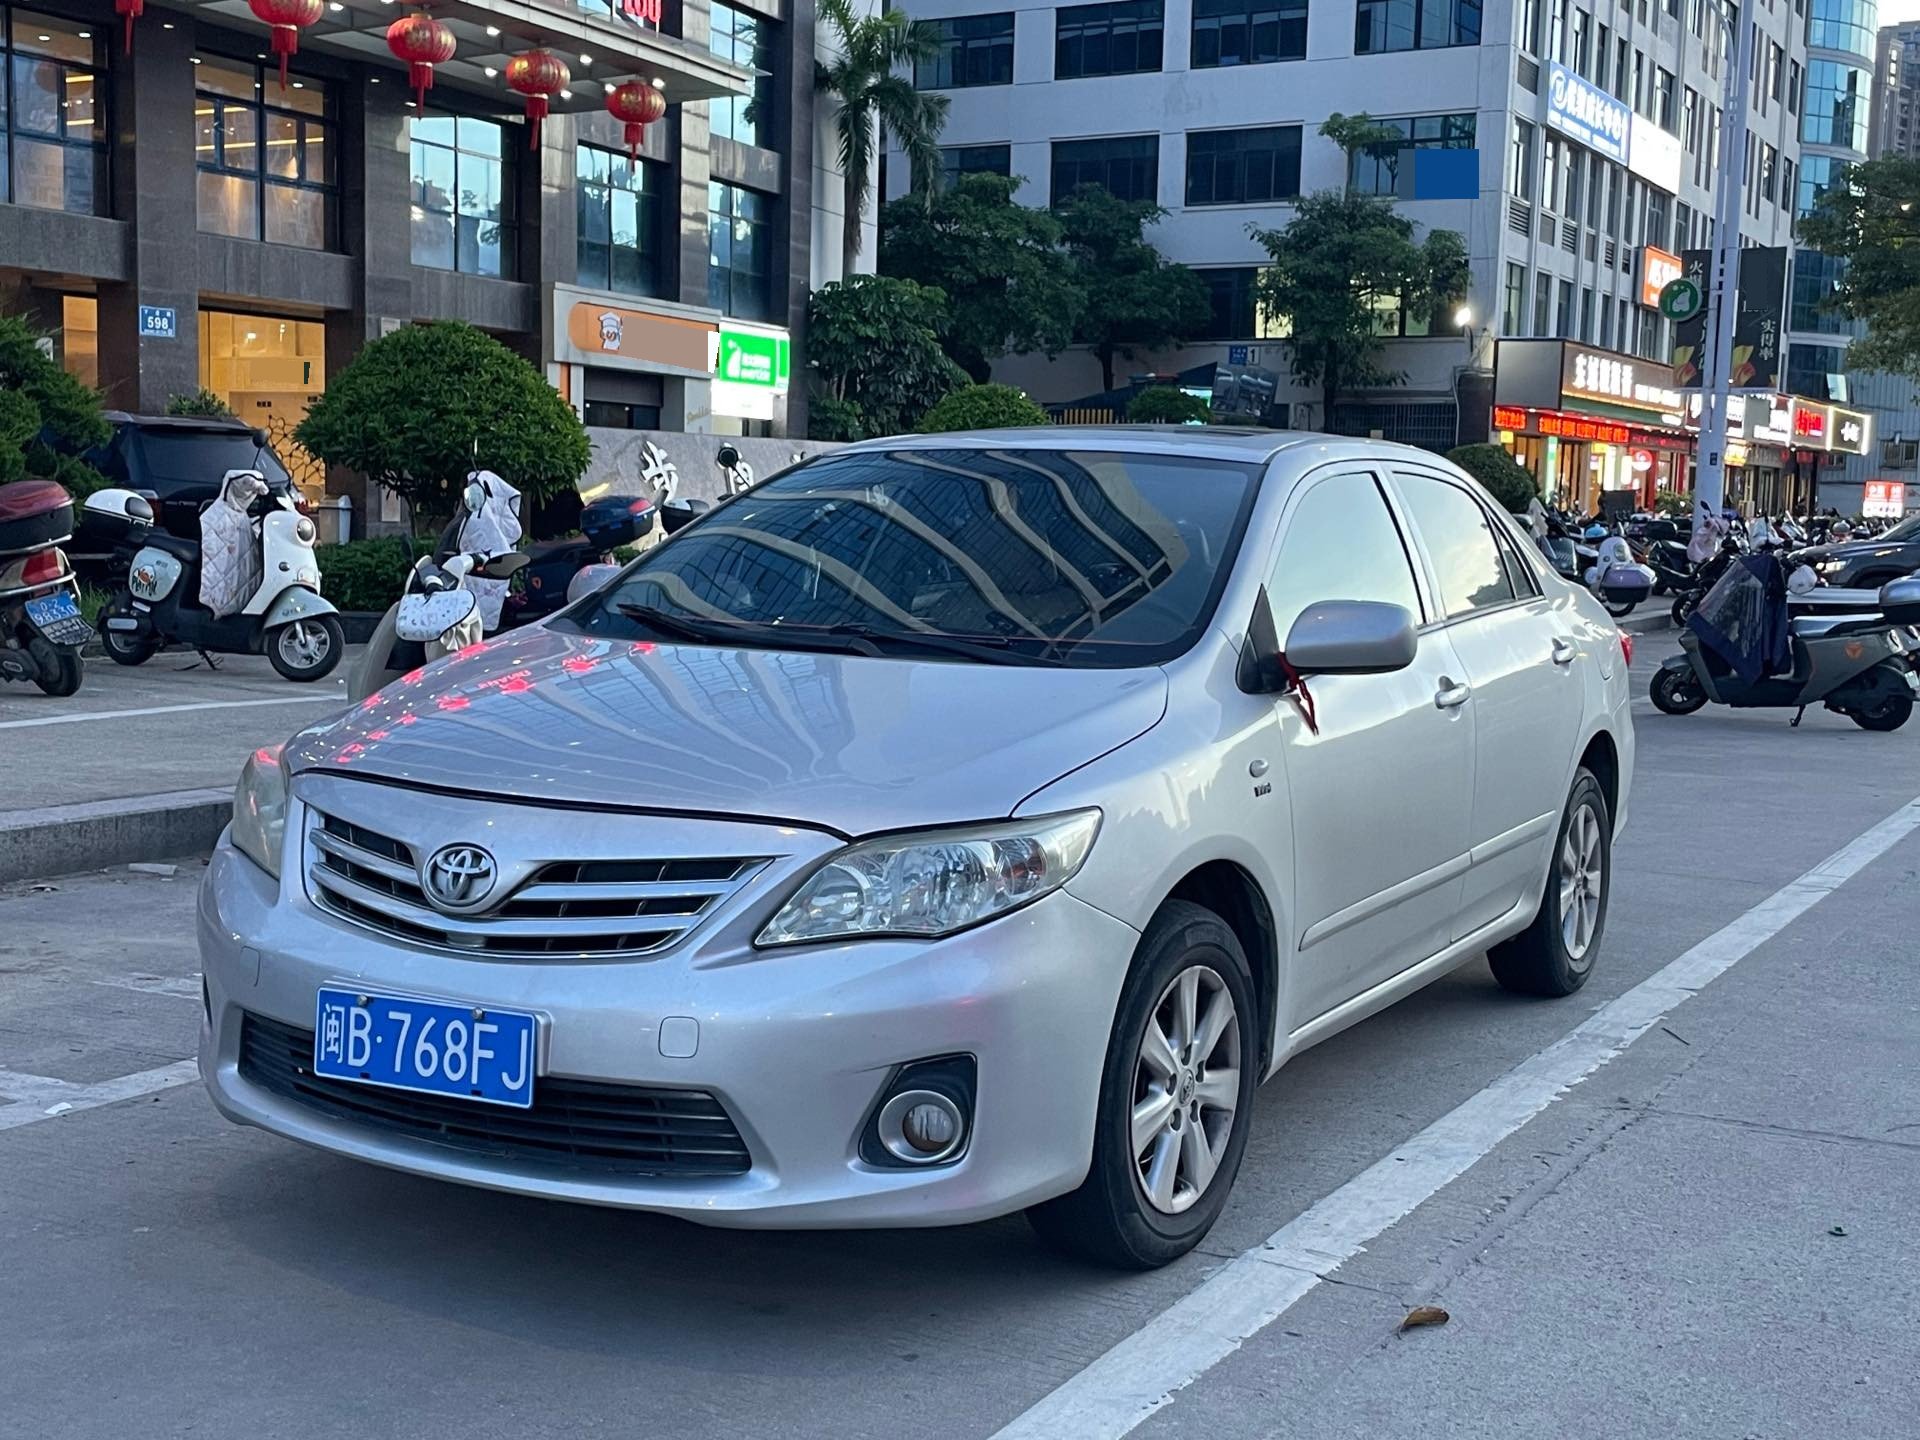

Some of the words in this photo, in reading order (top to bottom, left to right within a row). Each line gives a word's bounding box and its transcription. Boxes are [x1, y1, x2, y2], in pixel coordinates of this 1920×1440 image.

[147, 316, 169, 330] 598
[1758, 319, 1777, 361] 实得率
[34, 604, 77, 625] 98330
